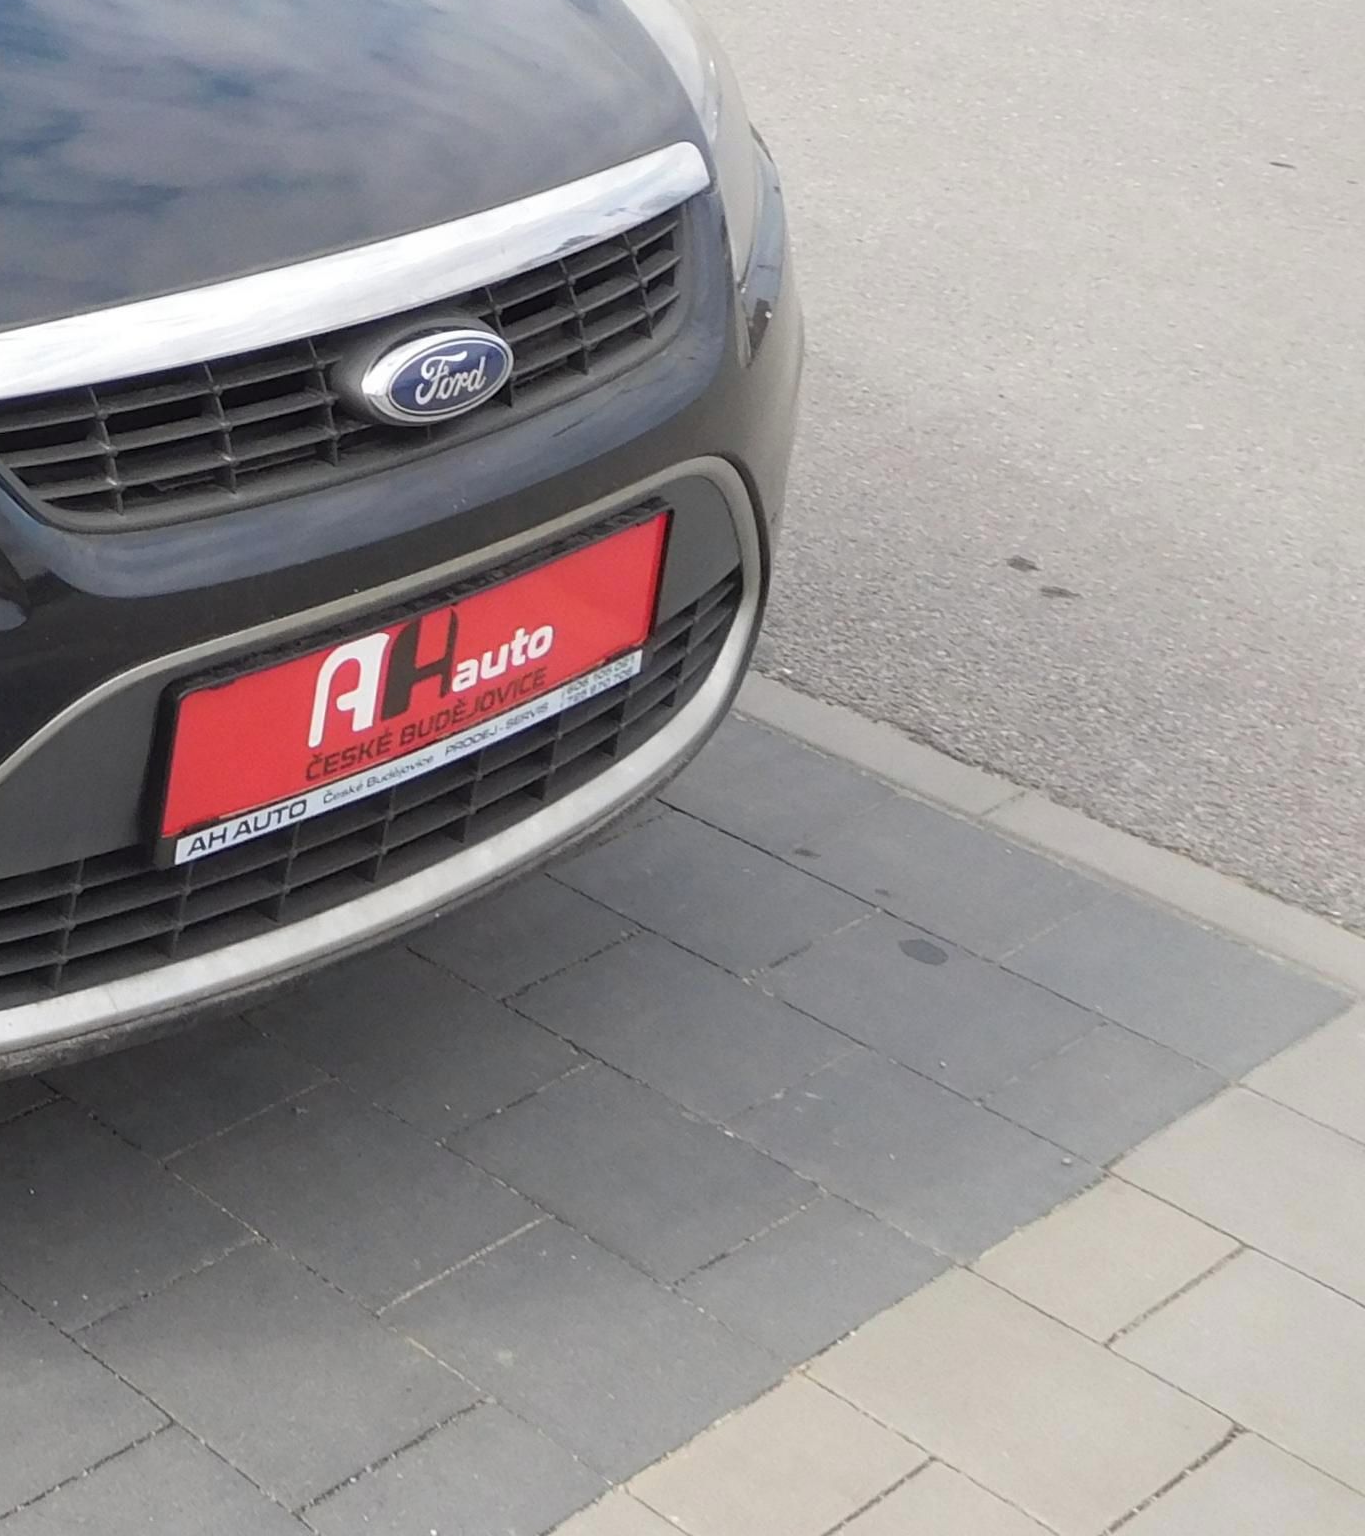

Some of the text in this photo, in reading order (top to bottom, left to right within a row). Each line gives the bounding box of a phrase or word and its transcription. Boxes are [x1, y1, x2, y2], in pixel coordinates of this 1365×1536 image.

[415, 350, 486, 405] Ford
[305, 666, 547, 782] ČESKÉ BUDĚJOVICE
[187, 827, 228, 856] AH
[232, 799, 307, 841] AUTO
[322, 779, 364, 805] České
[366, 754, 434, 789] Budějovice
[445, 726, 498, 756] PRODEJ
